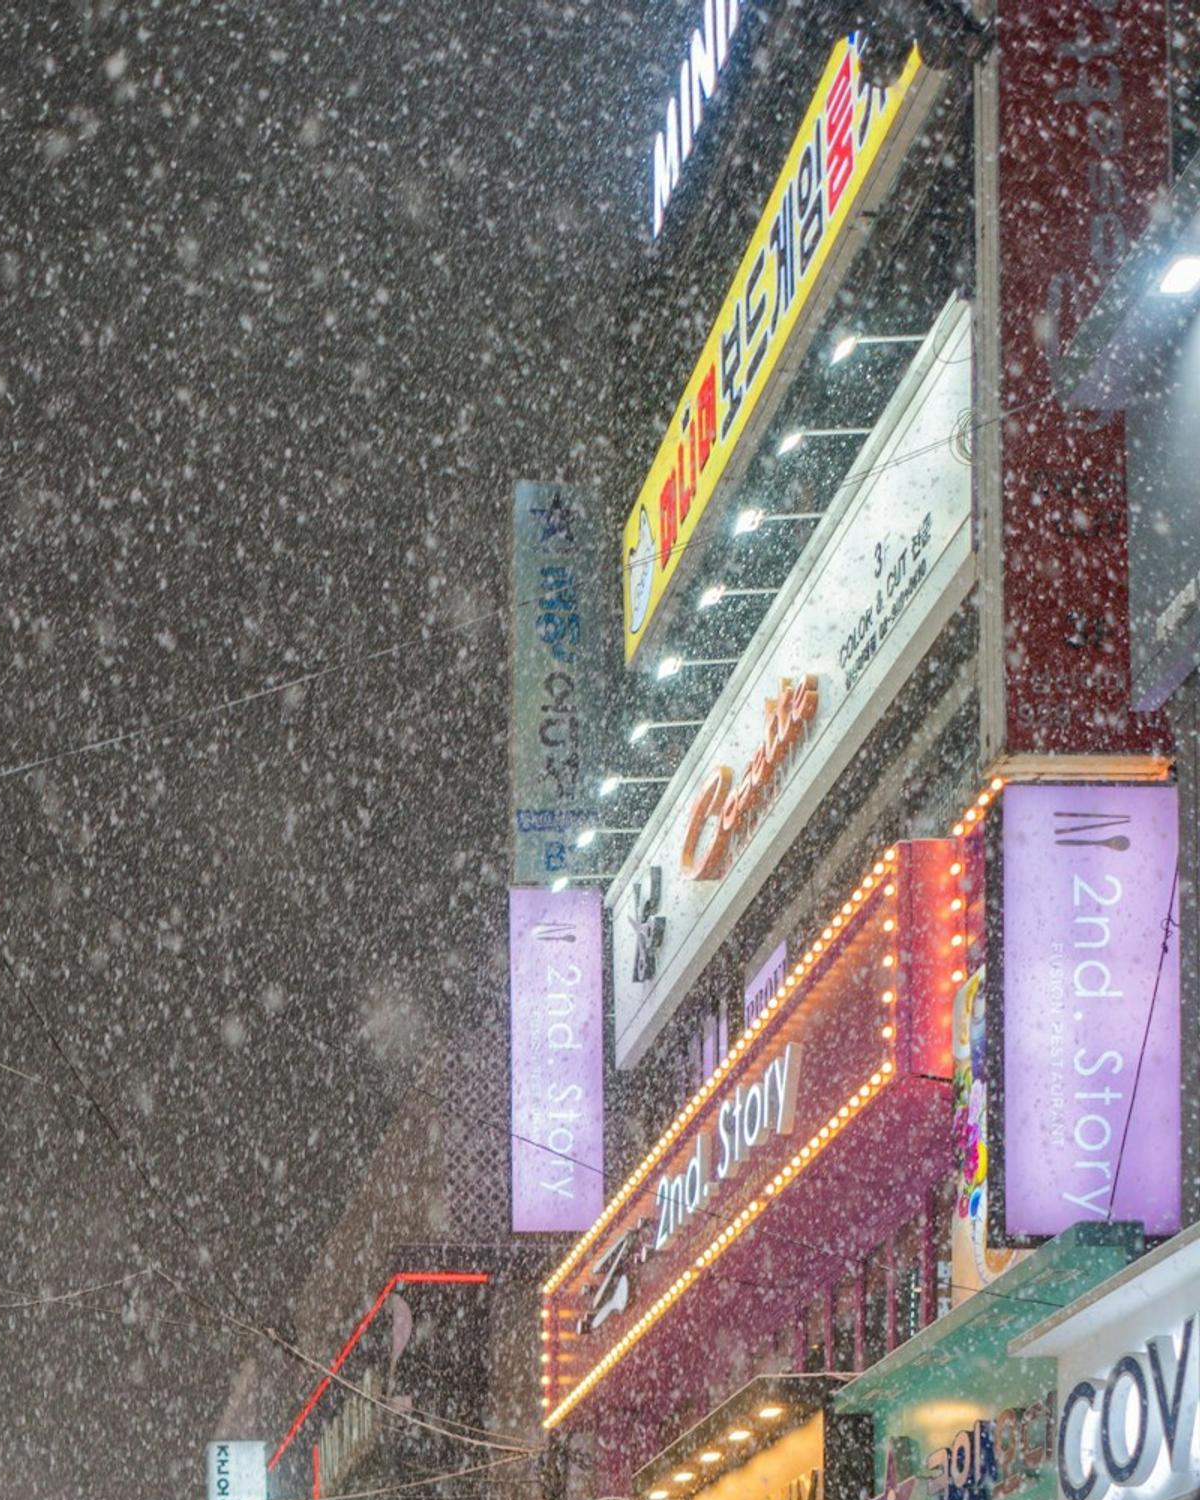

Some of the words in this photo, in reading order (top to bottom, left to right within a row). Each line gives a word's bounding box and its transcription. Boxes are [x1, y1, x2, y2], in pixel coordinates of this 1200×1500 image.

[838, 606, 873, 670] COLOR
[886, 547, 908, 598] CUT
[1047, 943, 1064, 1016] FUSION
[1072, 873, 1124, 1022] 2nd.
[540, 1083, 583, 1199] Story
[654, 1132, 709, 1252] 2nd.
[717, 1042, 794, 1180] Story
[1062, 1048, 1124, 1217] Story
